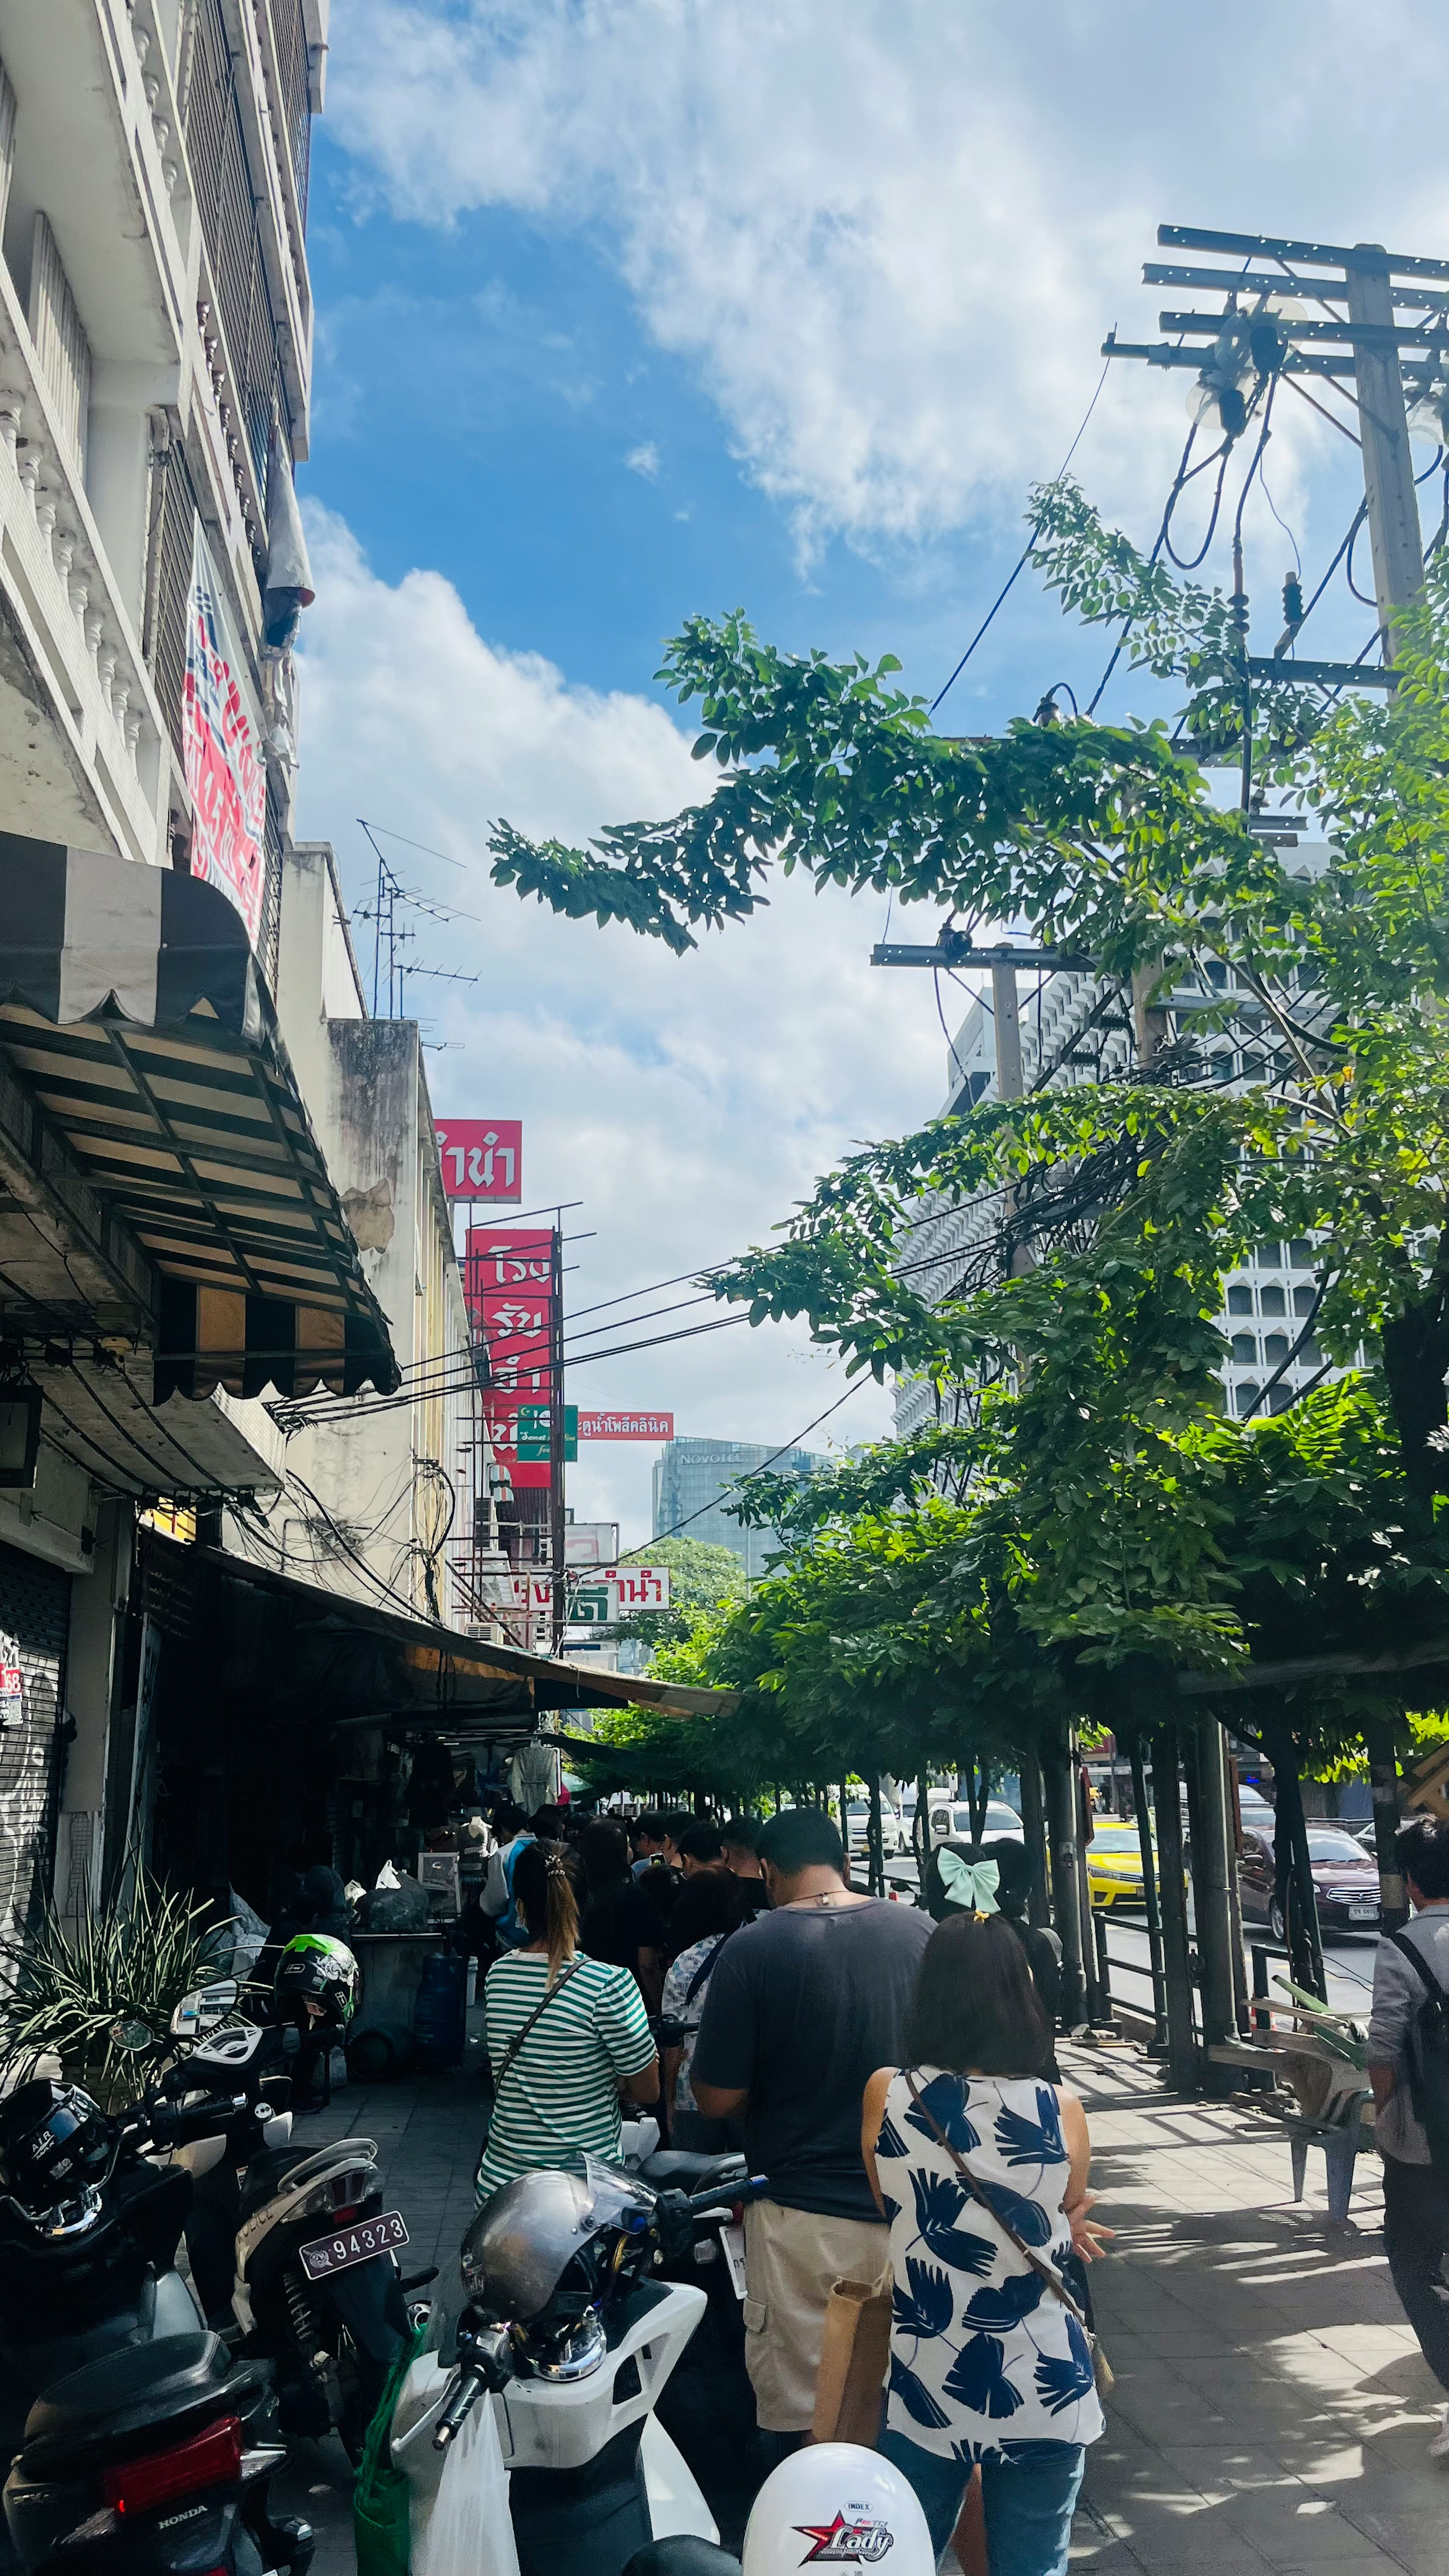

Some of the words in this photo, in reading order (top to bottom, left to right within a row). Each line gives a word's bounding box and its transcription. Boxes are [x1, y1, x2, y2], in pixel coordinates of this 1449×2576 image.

[435, 1131, 515, 1188] ำนำ
[680, 1453, 743, 1465] NOVOTEL
[32, 2131, 51, 2152] AIR
[332, 2219, 403, 2260] 94323
[158, 2505, 208, 2530] HONDA
[830, 2527, 893, 2561] Lady
